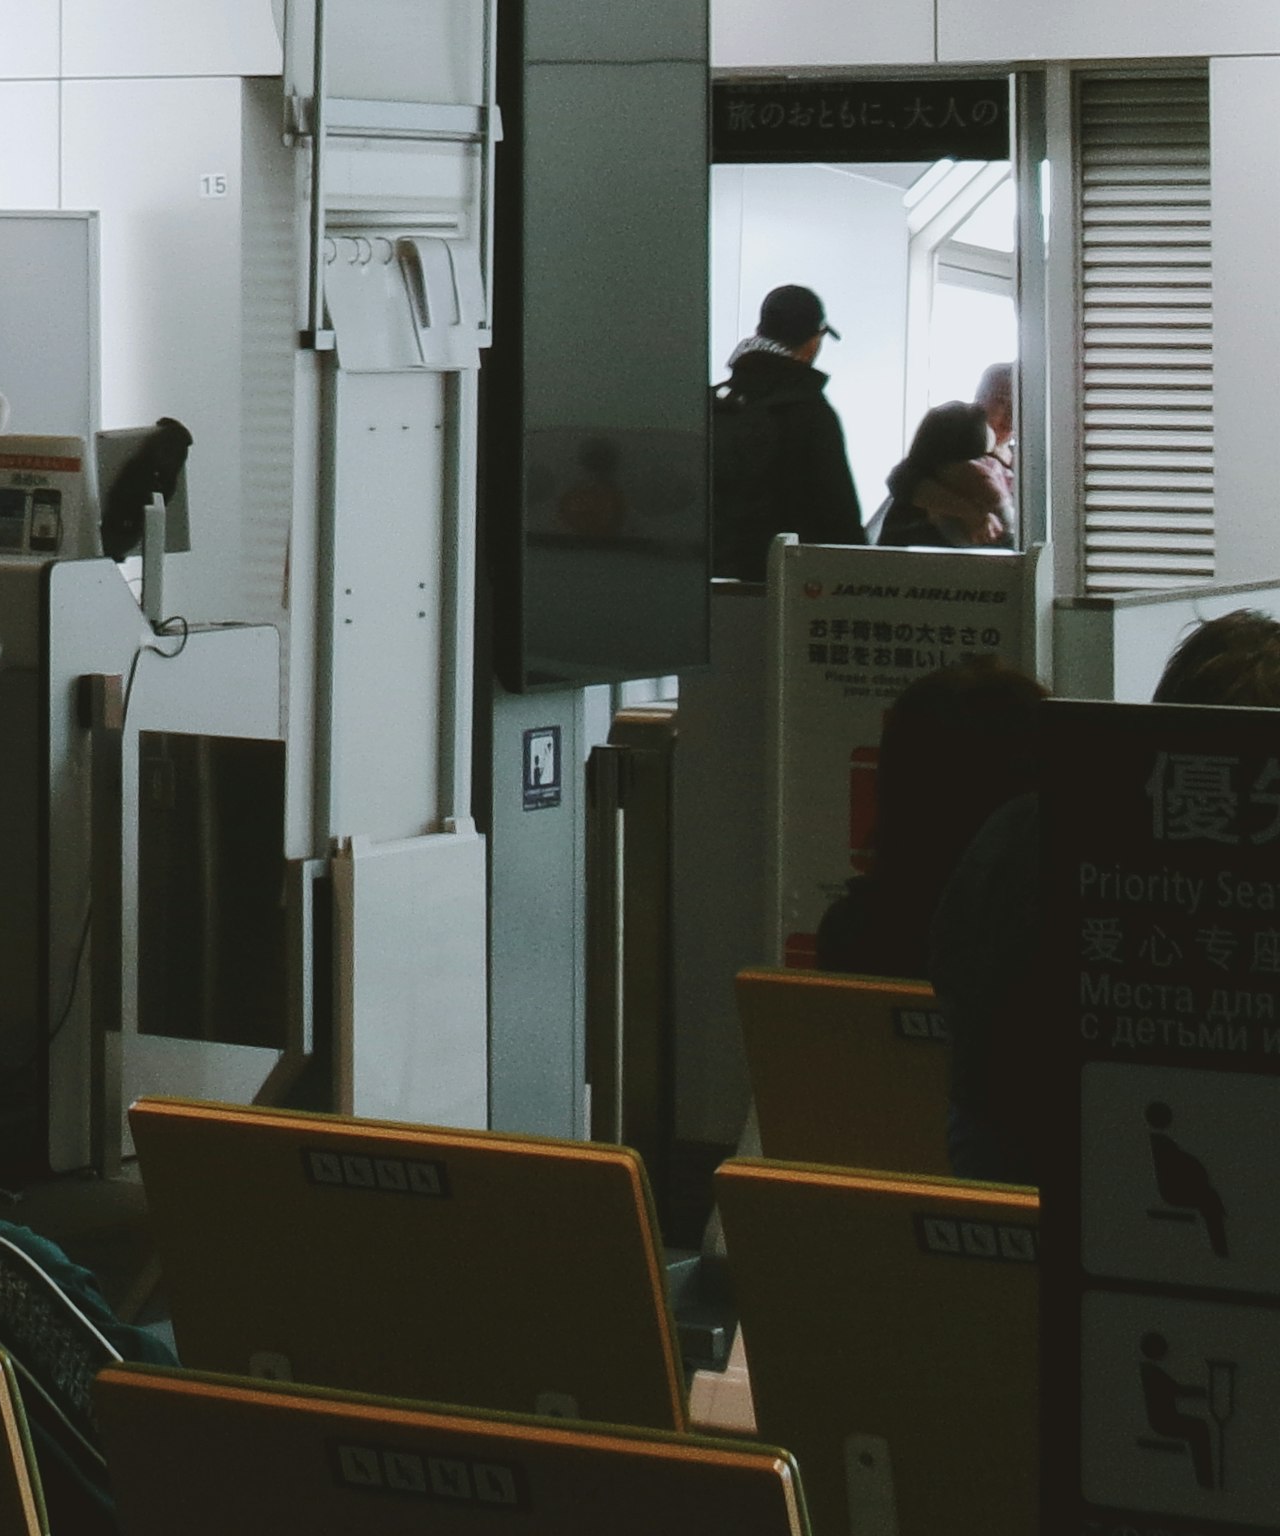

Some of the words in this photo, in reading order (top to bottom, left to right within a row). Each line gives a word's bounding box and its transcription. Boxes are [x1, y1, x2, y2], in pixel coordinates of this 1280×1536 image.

[727, 96, 1006, 131] 旅のおともに、大人の
[201, 175, 226, 195] 15
[831, 583, 900, 599] JAPAN
[904, 586, 1009, 604] AIRLINES
[809, 618, 1001, 646] お手荷物の大きさの
[1078, 860, 1206, 917] Priority
[1216, 870, 1280, 912] Sea
[1079, 970, 1193, 1014] Места
[1205, 986, 1274, 1022] для
[1079, 1012, 1100, 1041] с
[1110, 1015, 1248, 1053] детьми
